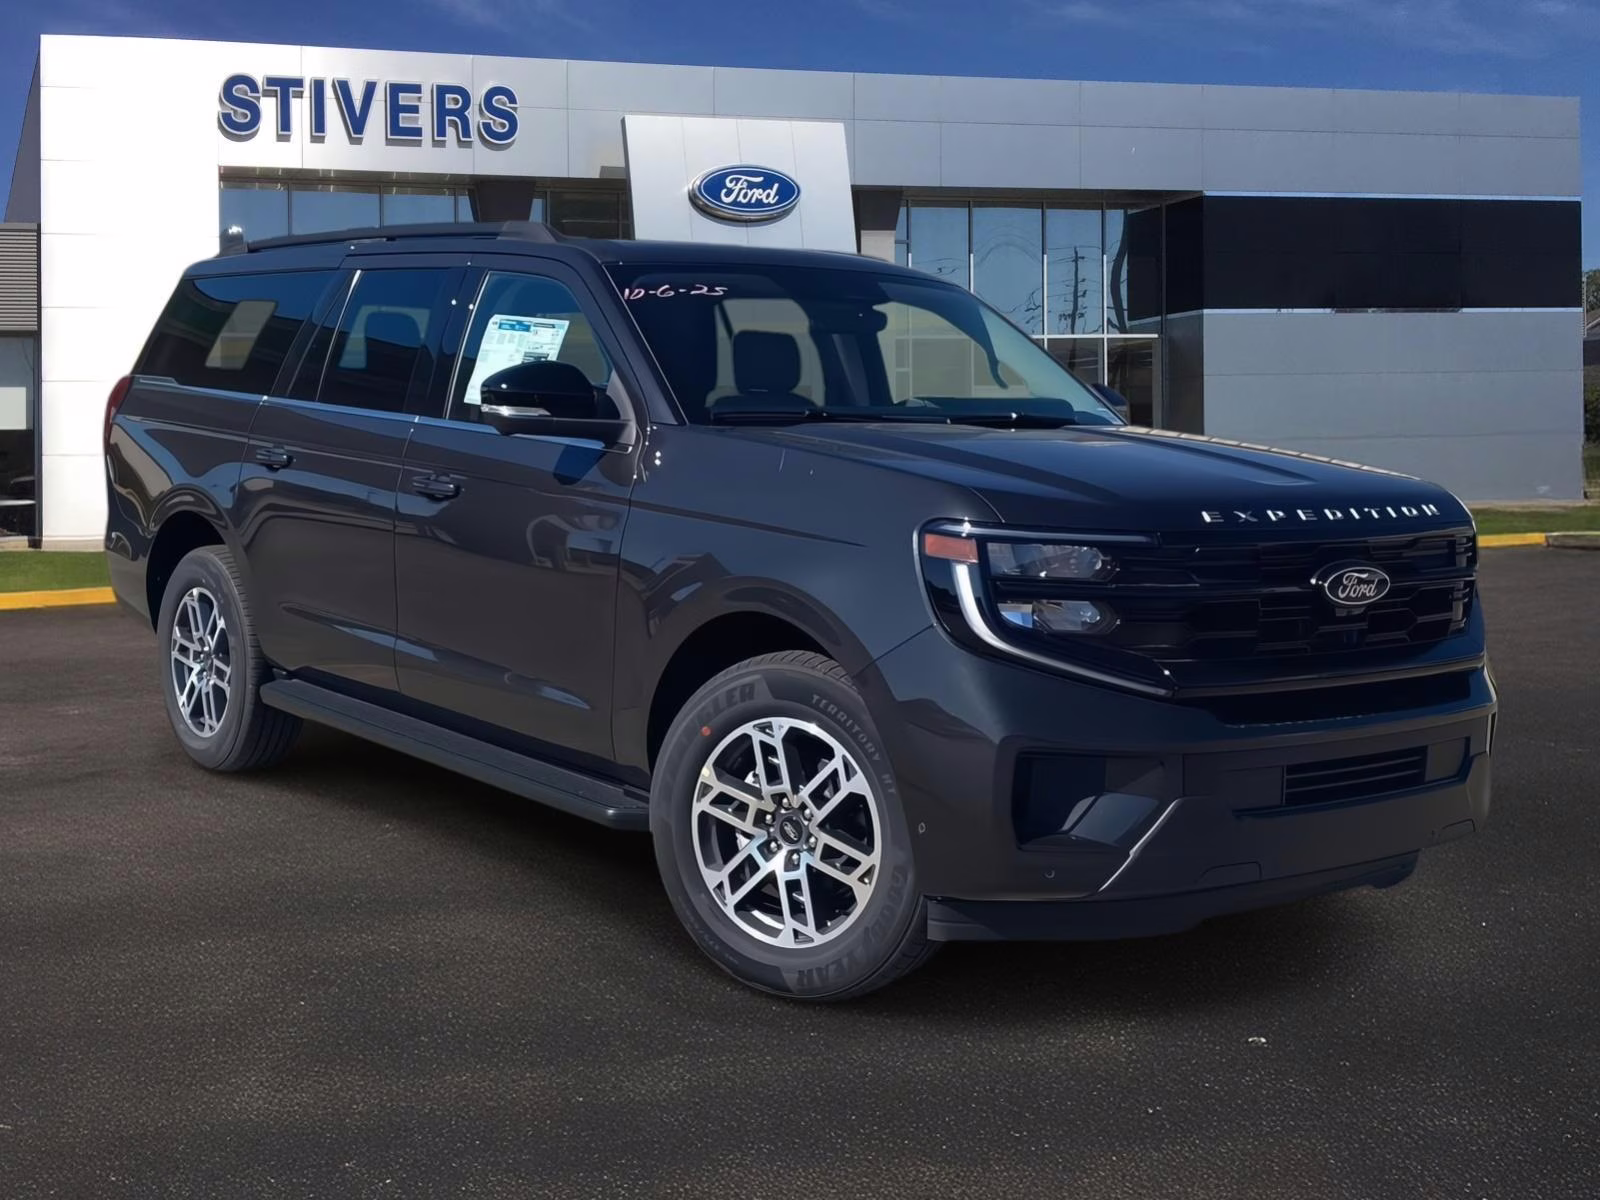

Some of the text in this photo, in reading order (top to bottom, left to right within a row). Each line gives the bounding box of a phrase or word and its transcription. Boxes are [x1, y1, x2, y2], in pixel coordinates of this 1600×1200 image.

[218, 72, 519, 145] STIVERS
[720, 174, 780, 204] Ford
[623, 284, 729, 300] 10-6-25
[1200, 503, 1441, 523] EXPEDITION
[1337, 571, 1379, 600] Ford
[811, 693, 881, 761] TERRITORY
